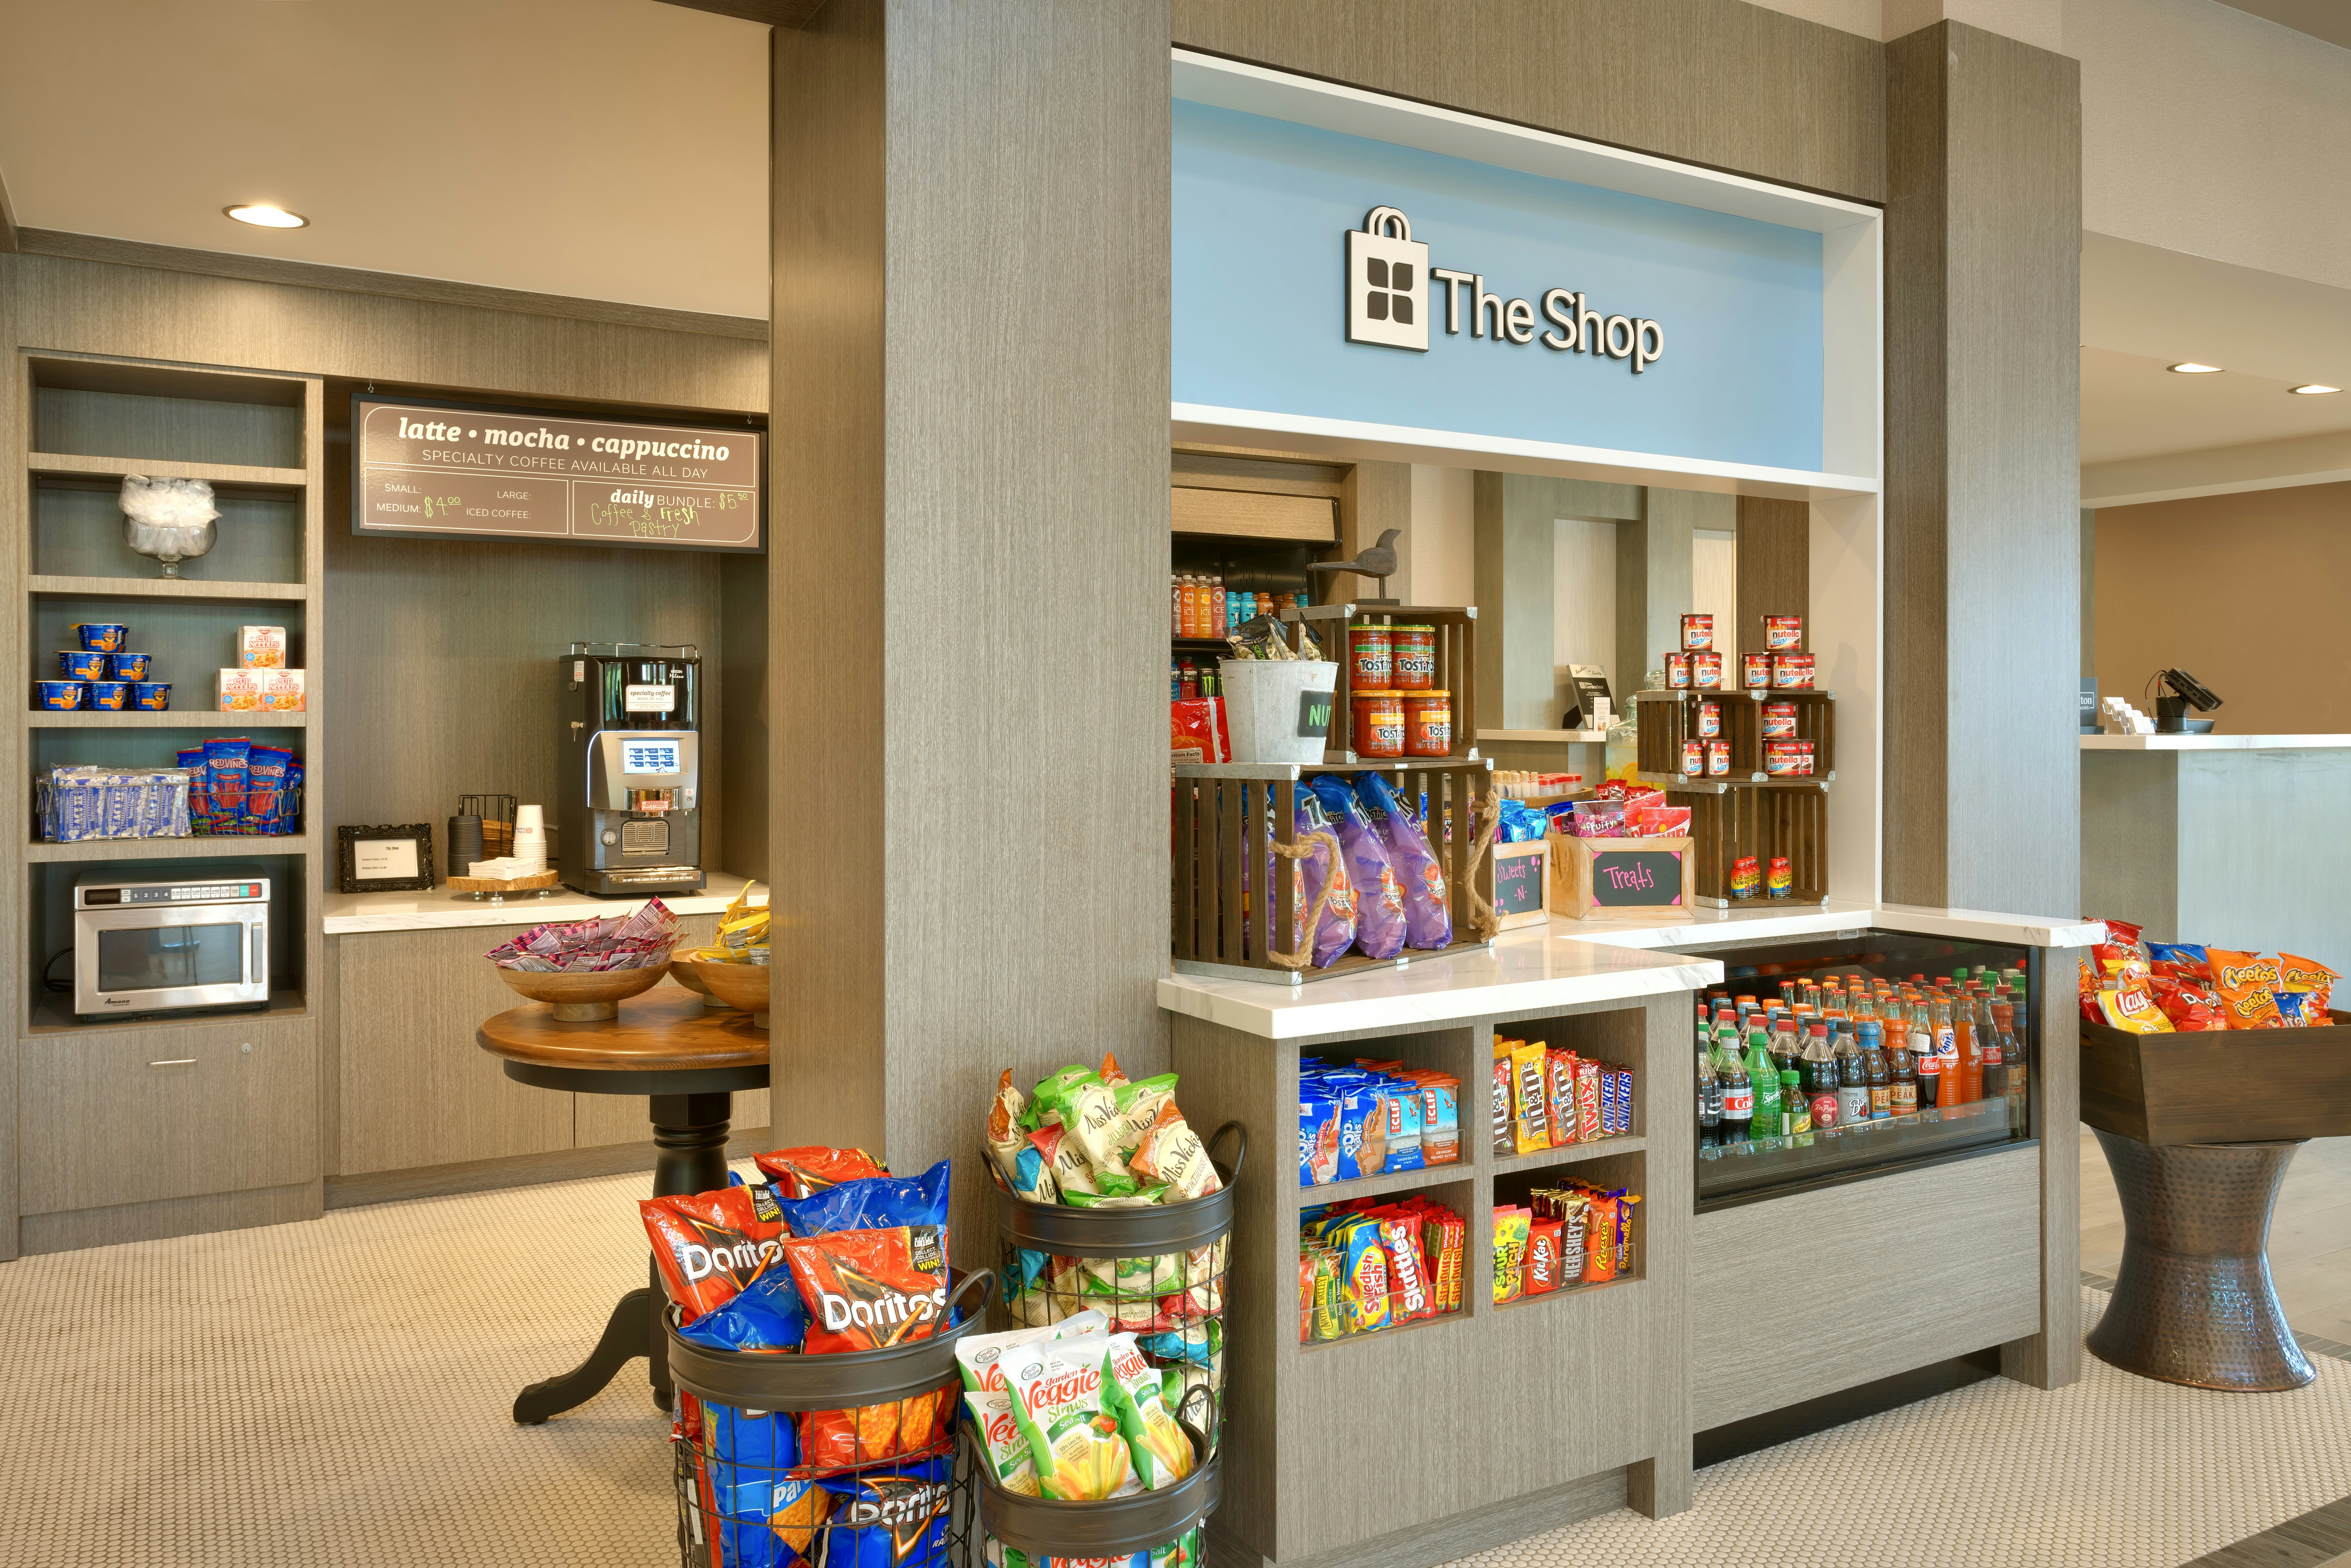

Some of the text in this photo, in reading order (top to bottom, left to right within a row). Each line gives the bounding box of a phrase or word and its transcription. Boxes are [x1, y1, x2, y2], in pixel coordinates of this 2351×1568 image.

[1430, 266, 1664, 375] The Shop
[399, 417, 729, 461] latte mocha cappuccino
[423, 450, 708, 478] SPECIALTY COFFEE AVAILABLE ALL DAY
[385, 484, 421, 493] SMALL:
[497, 491, 531, 500] LARGE:
[611, 489, 715, 508] daily BUNDLE:
[377, 503, 421, 513] MEDIUM:
[466, 508, 531, 519] ICED COFFEE:
[591, 503, 700, 526] Coffee & Fresh
[629, 519, 679, 538] Pastry
[1497, 862, 1526, 883] Sweets
[1603, 862, 1654, 891] Treats
[2223, 964, 2278, 987] Cheetos
[2254, 1005, 2273, 1019] Crunchy
[1937, 1032, 1954, 1055] Fanta
[1579, 1065, 1598, 1075] RIGHT
[1426, 1092, 1435, 1117] CLIF
[1577, 1077, 1599, 1139] TWIX
[1603, 1073, 1614, 1133] SNICKERS
[1617, 1072, 1631, 1133] SNICKERS
[1390, 1101, 1400, 1125] CLIF
[1084, 1114, 1107, 1134] Miss
[1179, 1159, 1207, 1198] SMOKEHOUSE
[756, 1198, 774, 1207] COLLECT.
[757, 1202, 776, 1212] COLLIDE.
[759, 1207, 781, 1221] WIN!
[915, 1246, 936, 1255] COLLECT.
[1564, 1214, 1583, 1278] HERSHEY'S
[1595, 1220, 1609, 1271] Reese's
[1619, 1218, 1632, 1269] Caramello
[916, 1251, 938, 1260] COLLIDE.
[918, 1258, 940, 1271] WIN!
[1507, 1242, 1520, 1286] PATCH
[1451, 1249, 1463, 1304] Starburst
[1496, 1246, 1508, 1287] SOUR
[1359, 1254, 1380, 1314] Swedish
[1371, 1263, 1386, 1298] Fish
[1438, 1250, 1451, 1304] Starburst
[1319, 1278, 1328, 1328] NATURE VALLEY
[978, 1347, 994, 1359] Sensible
[983, 1351, 998, 1362] Portions
[1112, 1353, 1130, 1365] garden
[1024, 1364, 1036, 1375] Sensible
[1027, 1369, 1040, 1380] Portions
[1045, 1371, 1077, 1388] garden
[1019, 1371, 1102, 1421] Veggie
[1060, 1417, 1073, 1430] Sea
[1059, 1445, 1068, 1453] 30%
[1072, 1451, 1088, 1462] Preservatives
[1073, 1445, 1083, 1453] Artificial
[1010, 1455, 1023, 1469] Sea
